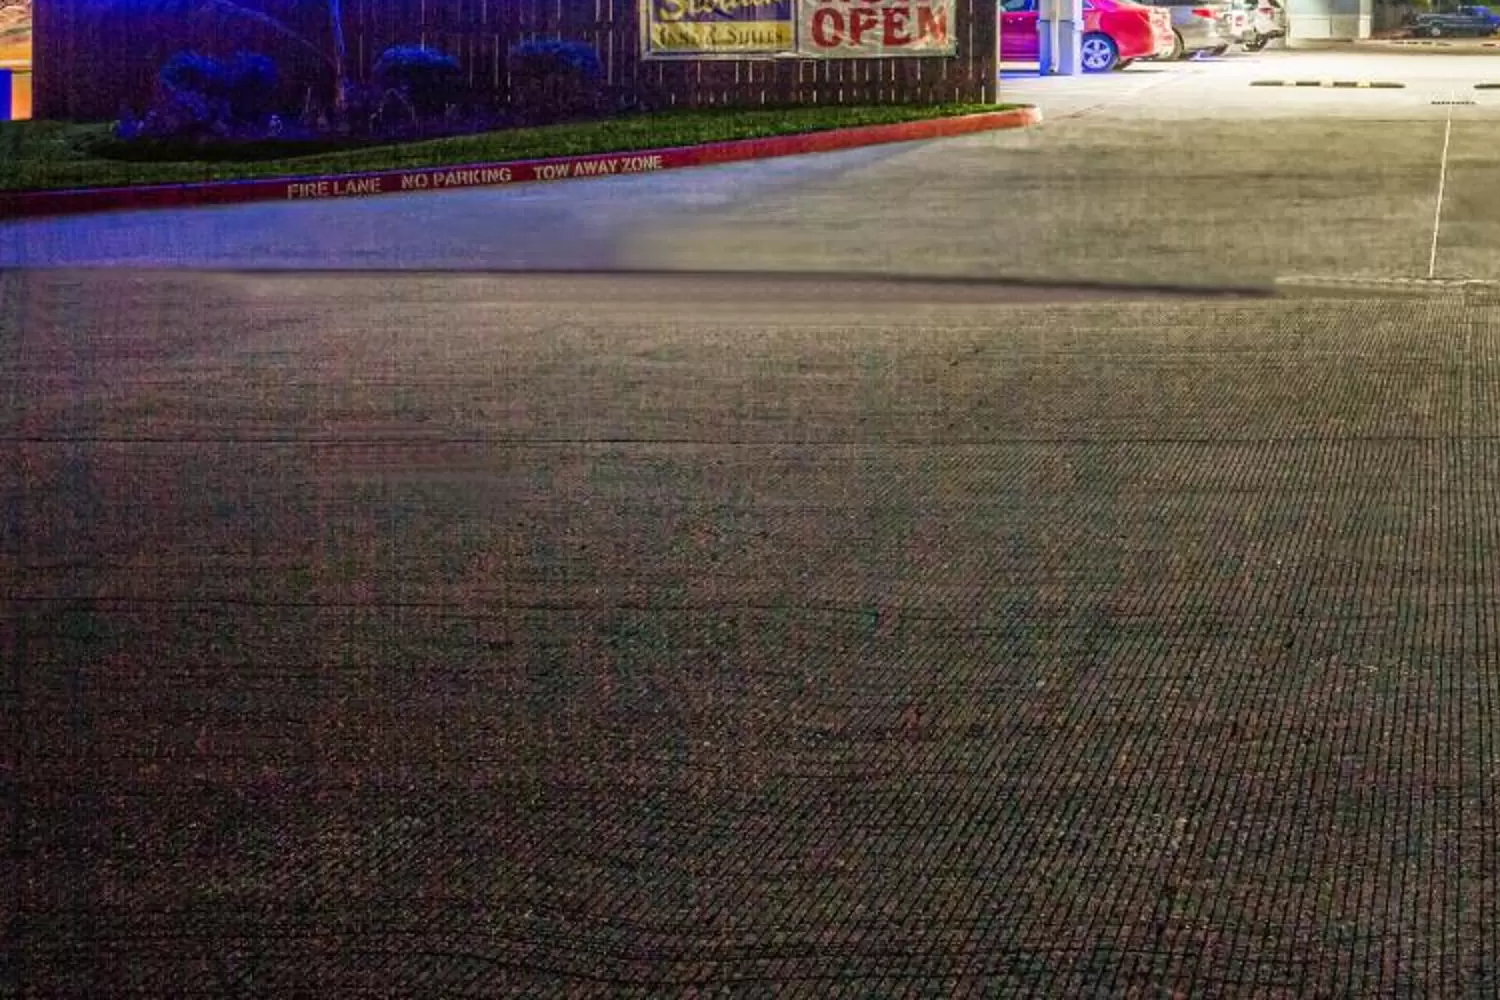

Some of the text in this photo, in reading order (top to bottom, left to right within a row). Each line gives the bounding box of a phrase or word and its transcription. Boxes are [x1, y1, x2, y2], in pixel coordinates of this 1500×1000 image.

[810, 5, 947, 49] OPEN
[287, 154, 663, 199] FIRE LANE NO PARKING TOW AWAY ZONE
